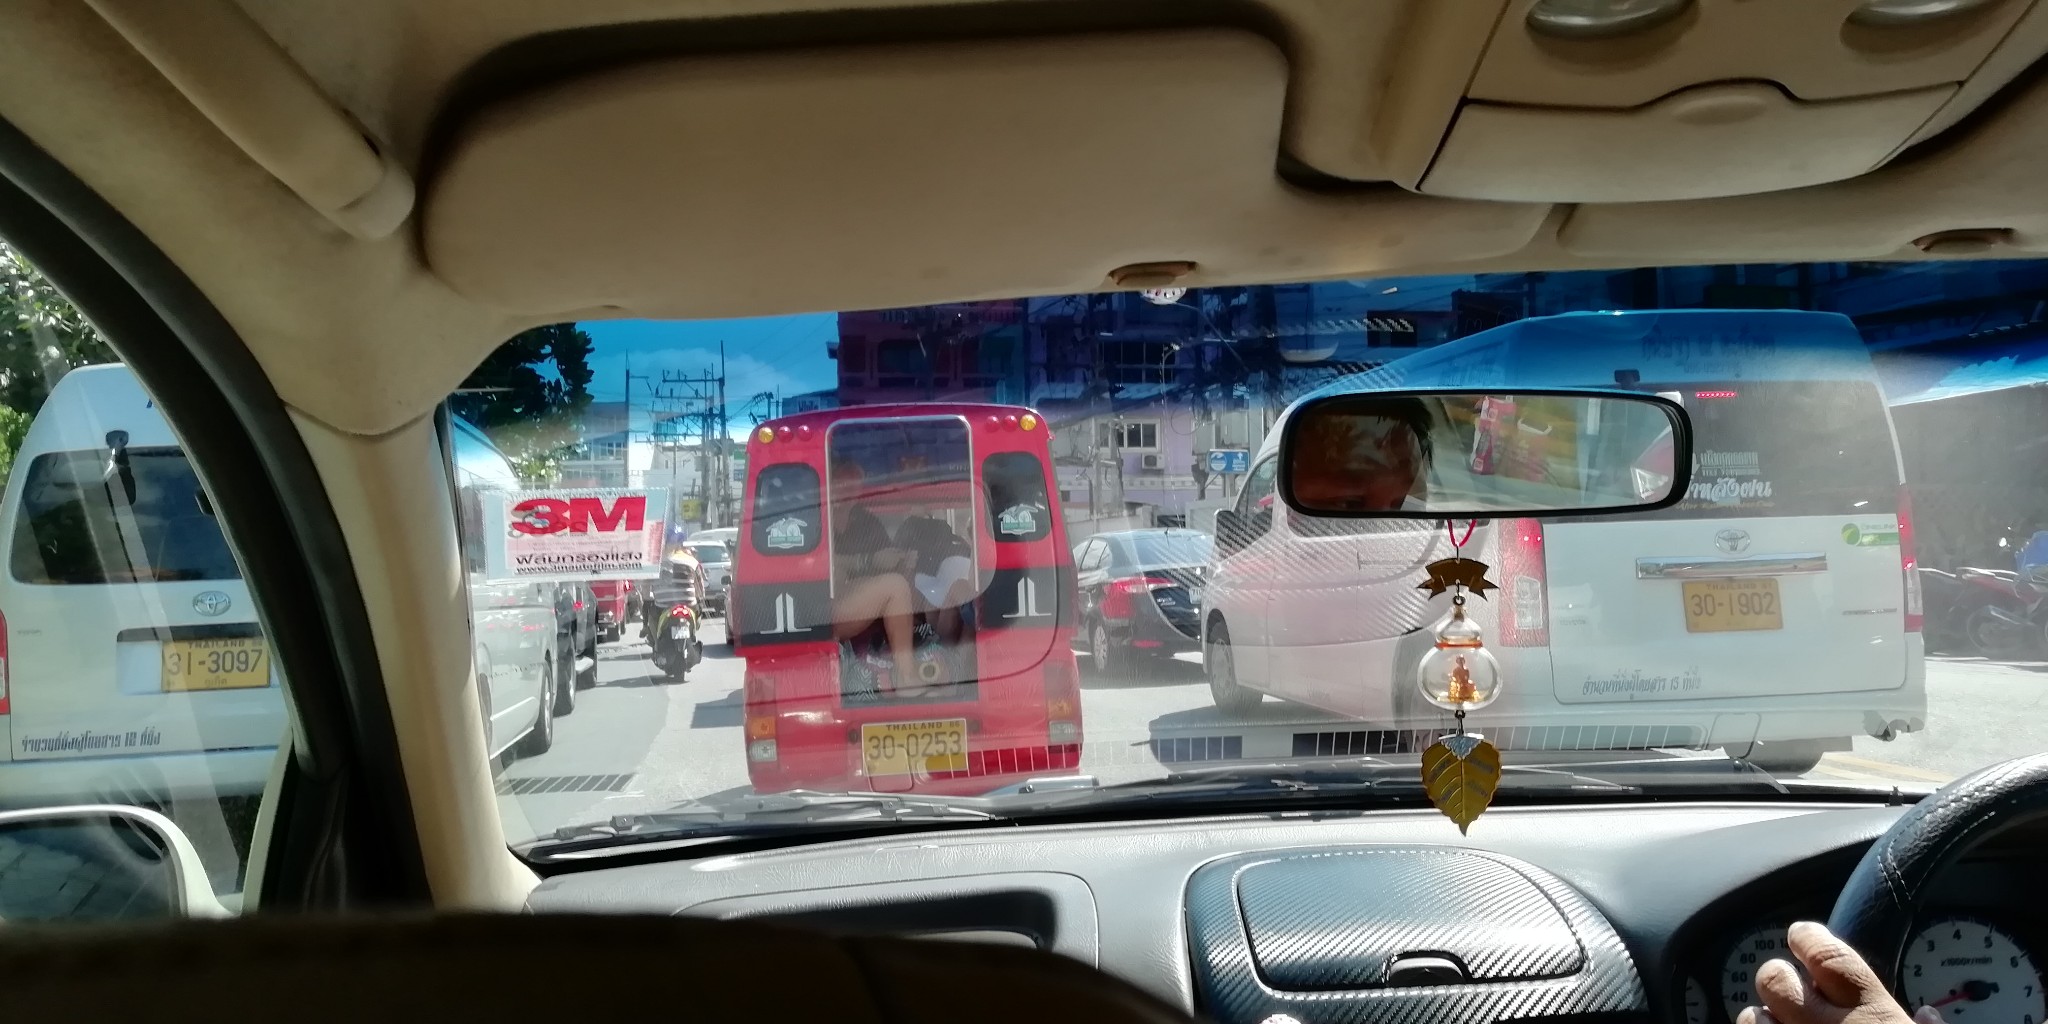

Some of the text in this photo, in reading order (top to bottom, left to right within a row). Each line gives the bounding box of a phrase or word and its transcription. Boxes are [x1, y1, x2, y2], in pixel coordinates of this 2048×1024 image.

[512, 496, 646, 535] 3M
[1691, 592, 1776, 616] 30-1902
[168, 649, 262, 675] 31-3097
[886, 722, 943, 731] THAILAND
[868, 731, 962, 760] 30-0253
[1953, 929, 1962, 940] 4
[1755, 940, 1775, 950] 100
[1927, 940, 1935, 952] 3
[1984, 936, 1993, 949] 5
[1739, 953, 1756, 964] 80
[2010, 956, 2019, 968] 6
[1914, 964, 1922, 977] 2
[1731, 971, 1747, 983] 60
[1731, 991, 1748, 1003] 40
[2023, 986, 2032, 998] 7
